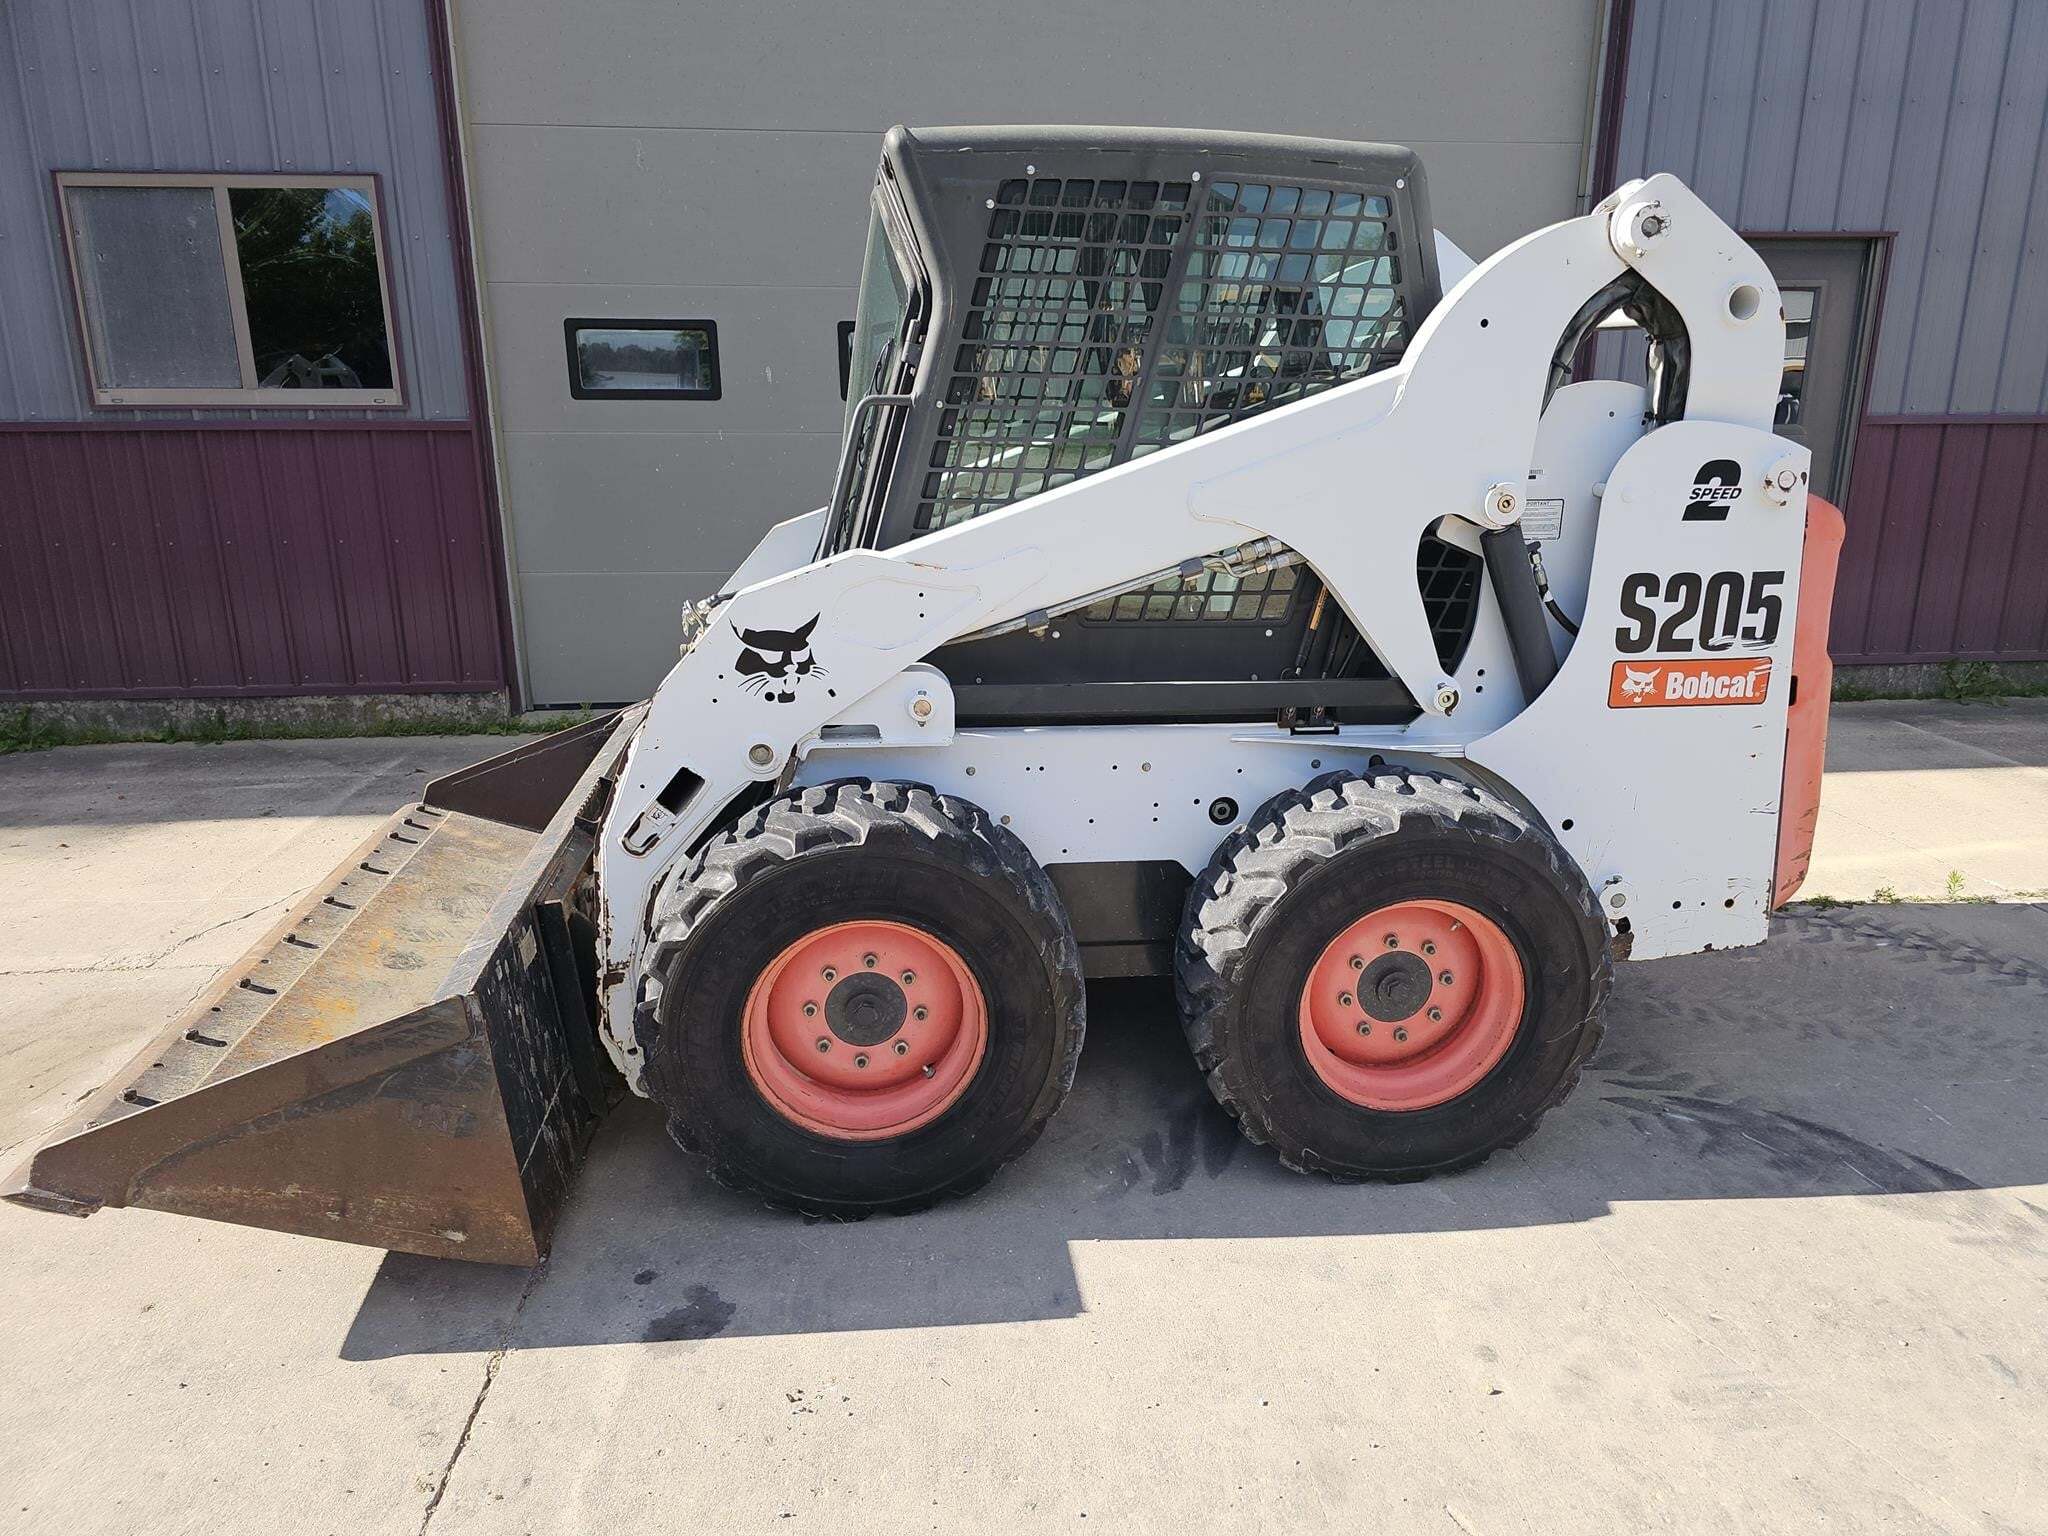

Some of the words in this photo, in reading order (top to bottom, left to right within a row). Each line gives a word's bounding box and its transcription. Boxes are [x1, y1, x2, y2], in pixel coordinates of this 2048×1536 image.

[1682, 459, 1742, 521] 2
[1689, 487, 1742, 500] SPEED
[1615, 571, 1785, 653] S205
[1665, 671, 1756, 700] Bobcat
